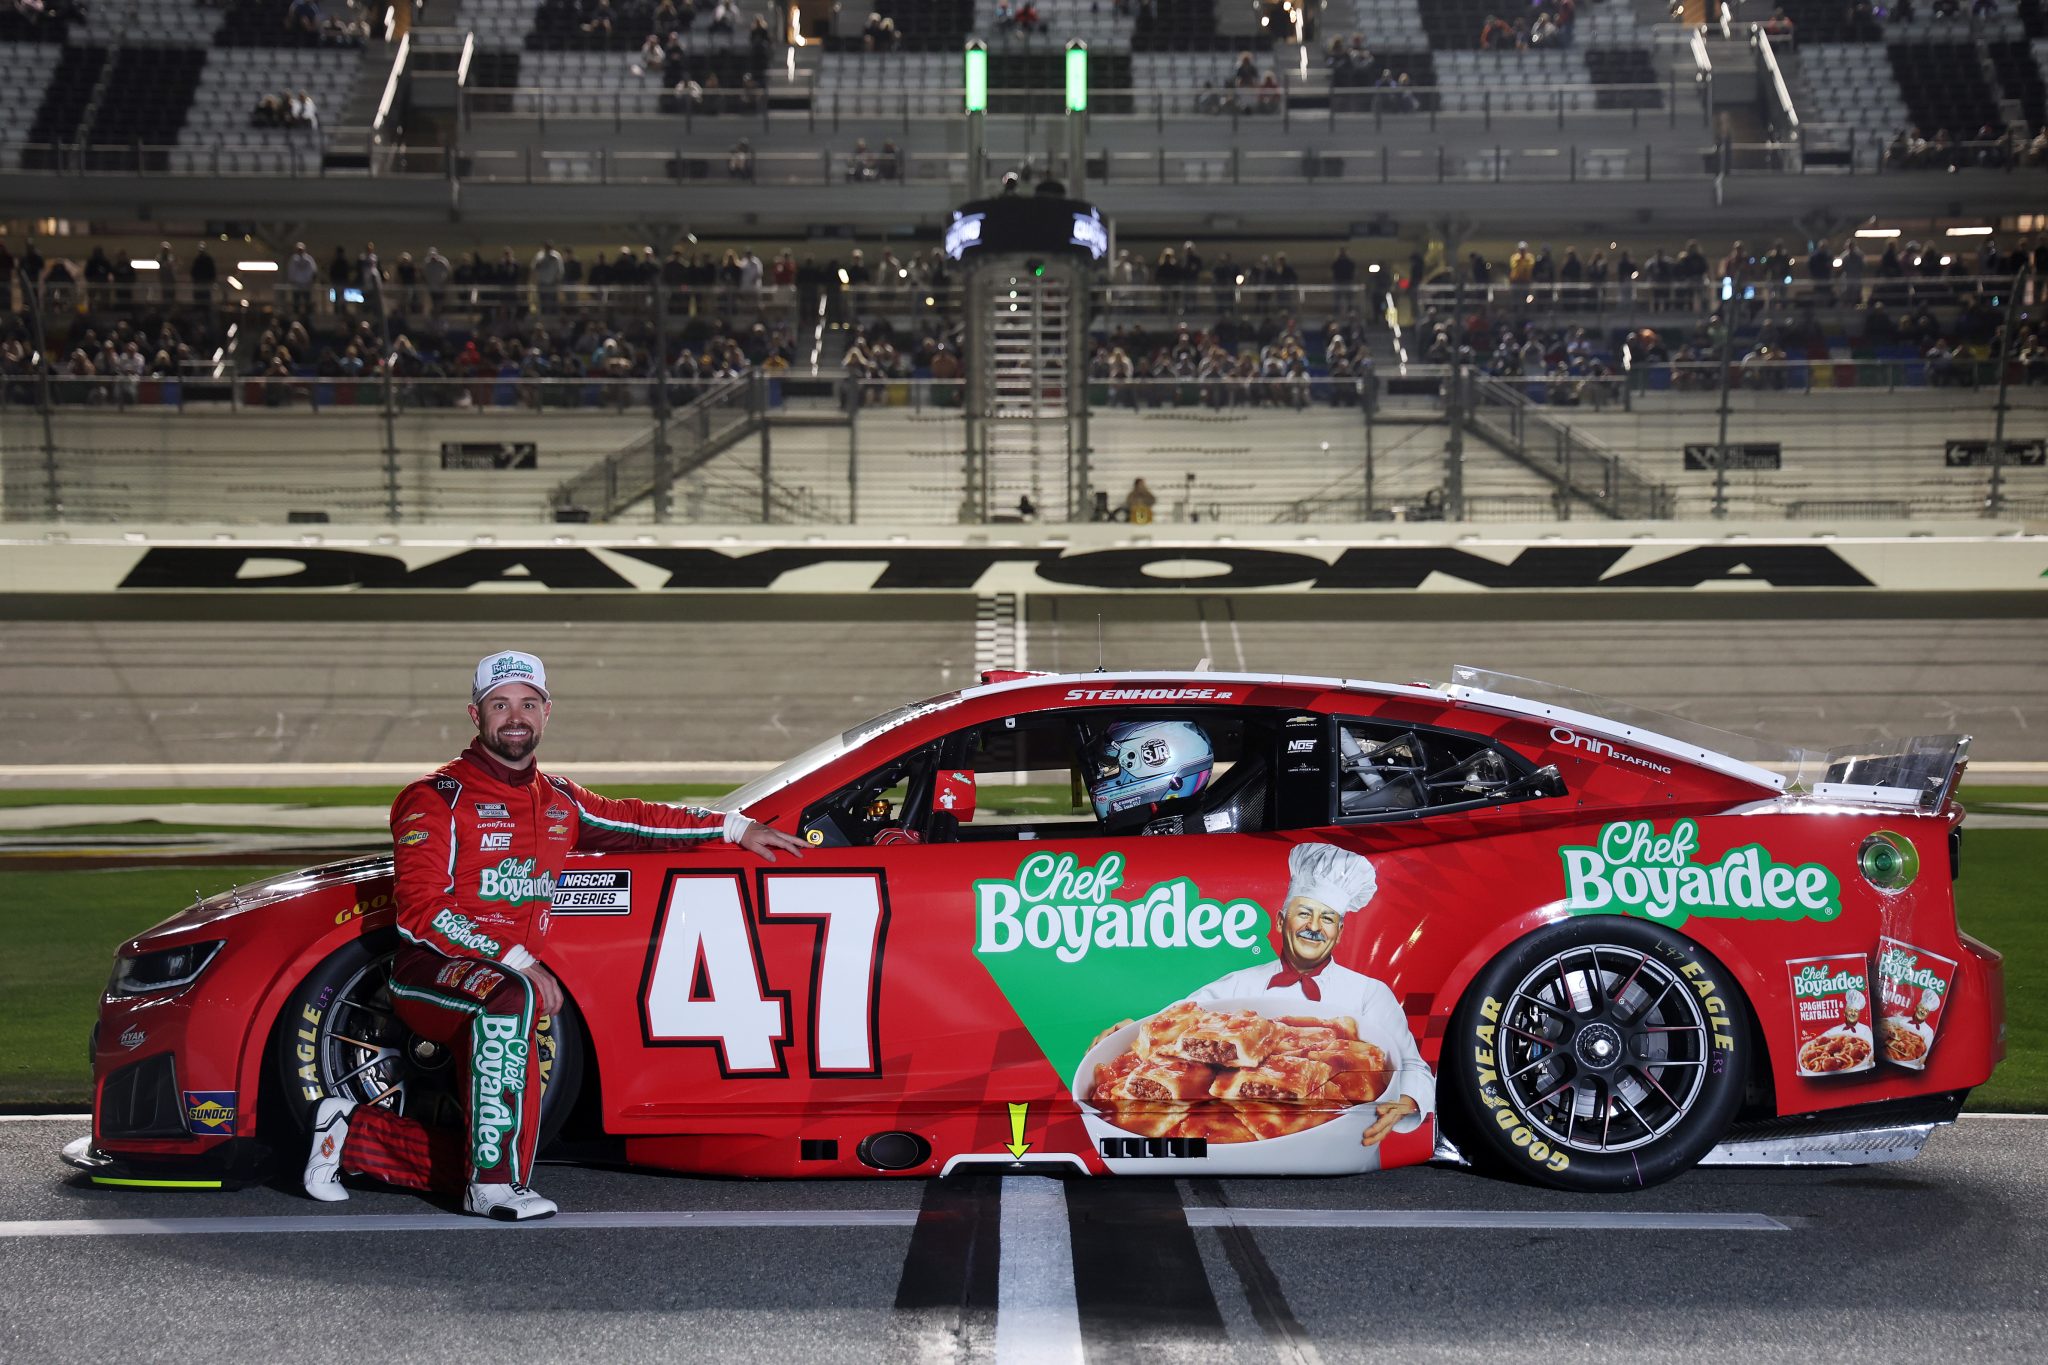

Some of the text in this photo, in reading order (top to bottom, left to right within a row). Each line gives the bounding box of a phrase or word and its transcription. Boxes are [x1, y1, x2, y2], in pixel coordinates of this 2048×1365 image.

[116, 546, 1878, 589] DAYTONA
[491, 672, 526, 683] RACING
[1064, 688, 1233, 700] STENHOUSE JR
[1612, 751, 1672, 774] STAFFING
[477, 821, 516, 829] GOODYEAR
[400, 832, 429, 843] SUNOCO
[481, 832, 512, 847] NOS
[1602, 821, 1695, 867] Chef
[498, 857, 536, 878] Chef
[480, 868, 556, 902] Boyarde
[563, 874, 616, 887] NASCAR
[1019, 855, 1120, 904] Chef
[1563, 848, 1829, 917] Boyardee
[553, 893, 617, 905] UP SERIES
[432, 908, 500, 954] Boyardee
[978, 882, 1258, 963] Boyardee
[1891, 949, 1917, 967] Chef
[637, 867, 891, 1080] 47
[1801, 964, 1828, 980] Chef
[1793, 972, 1864, 996] Boyardee
[1680, 961, 1734, 1052] EAGLE
[1799, 1000, 1838, 1011] SPAGHETTI
[1800, 1009, 1839, 1021] MEATBALLS
[121, 1031, 146, 1041] HYAK
[297, 1003, 324, 1101] EAGLE
[502, 1039, 528, 1091] Chef
[475, 1015, 519, 1164] Boyardee
[1475, 996, 1569, 1172] GOODYEAR
[190, 1108, 235, 1120] SUNOCO
